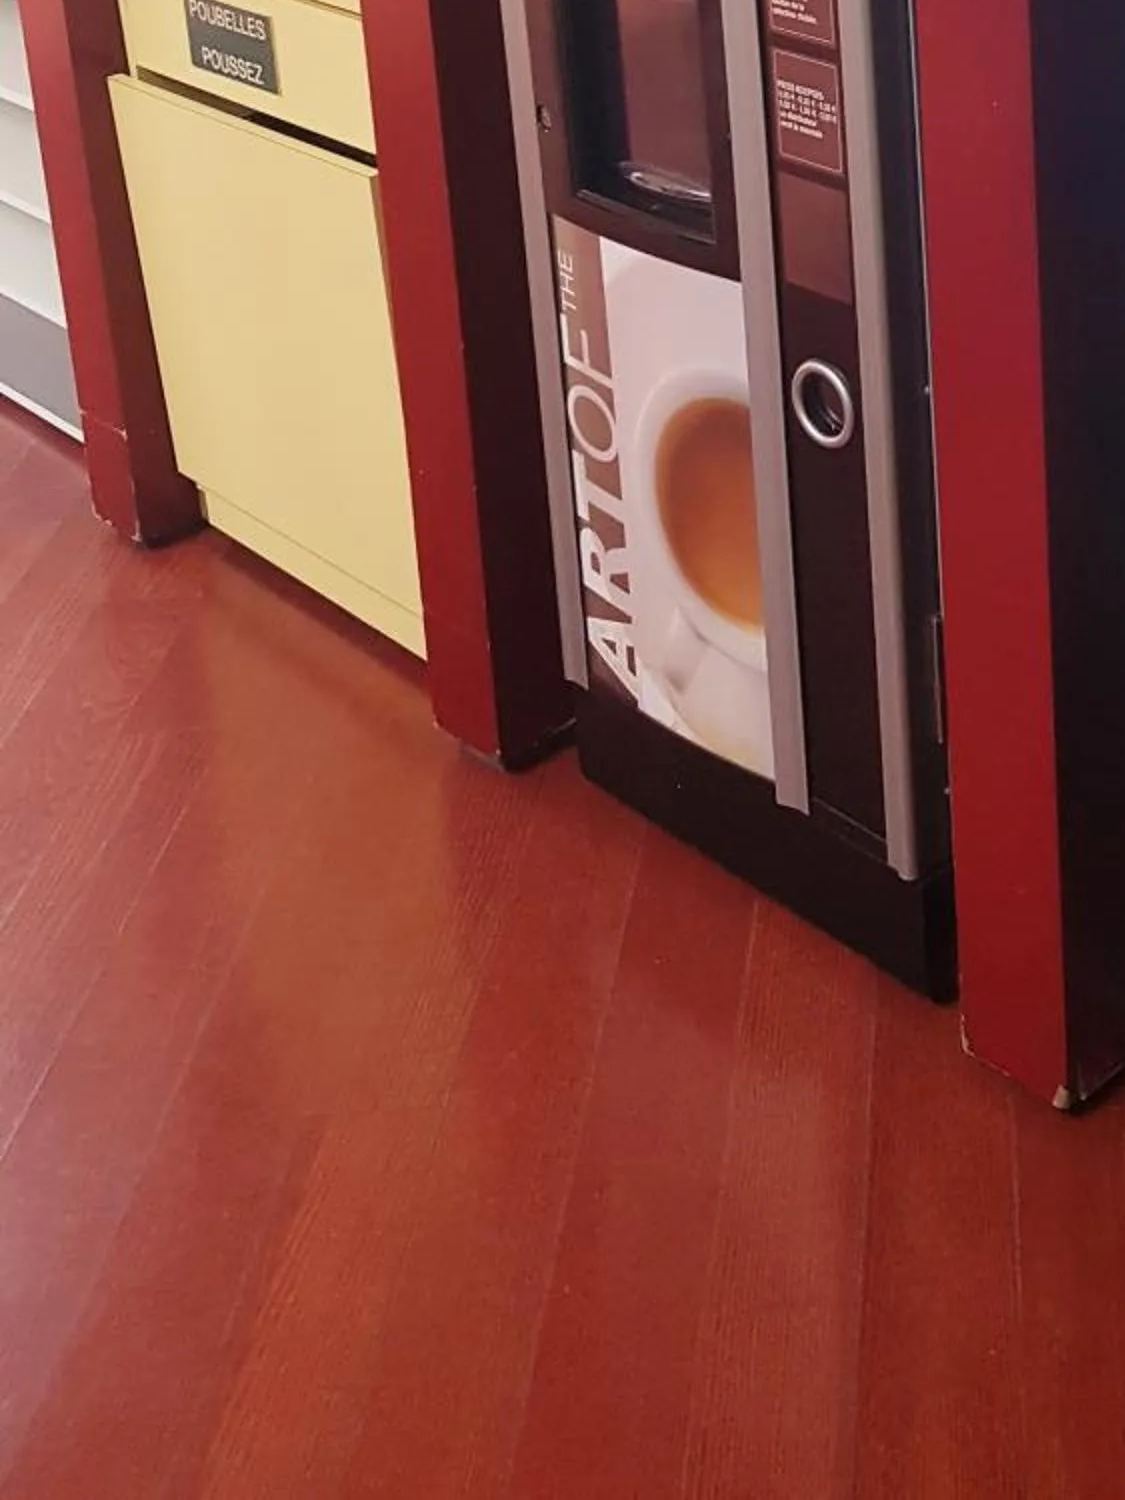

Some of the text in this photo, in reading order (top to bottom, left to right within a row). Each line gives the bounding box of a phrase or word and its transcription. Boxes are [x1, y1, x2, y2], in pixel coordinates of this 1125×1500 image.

[201, 45, 265, 85] POUSSEZ
[560, 313, 619, 463] OF
[573, 450, 642, 699] ART
